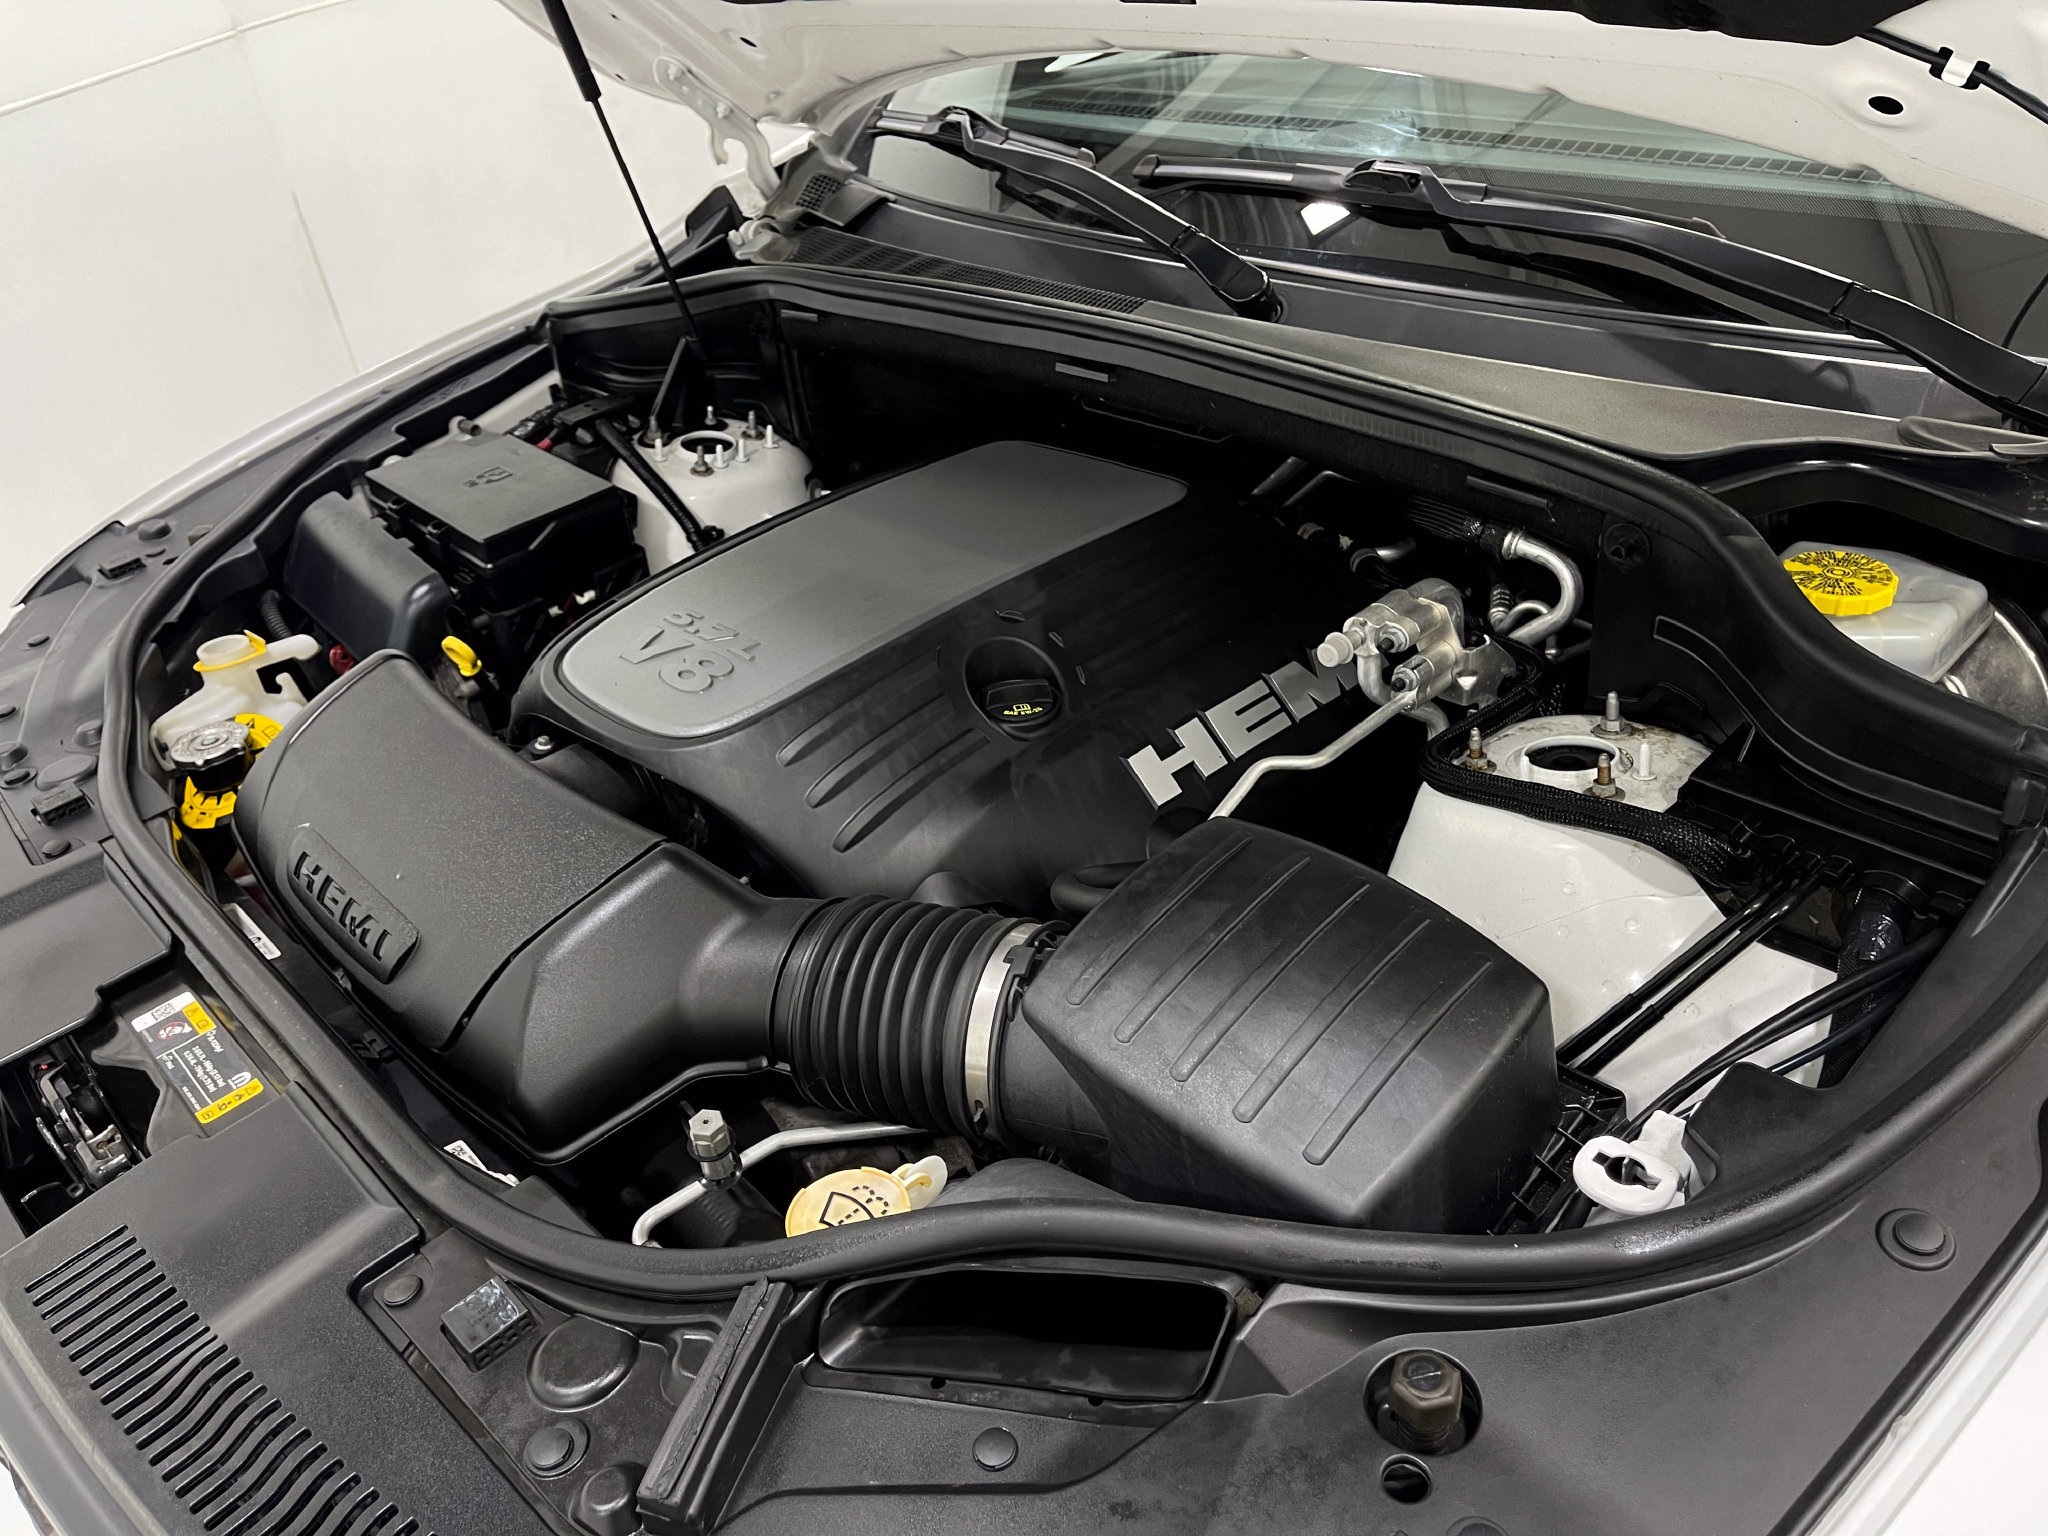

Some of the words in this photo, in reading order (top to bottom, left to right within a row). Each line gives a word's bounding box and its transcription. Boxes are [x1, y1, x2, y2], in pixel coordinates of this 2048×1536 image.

[619, 625, 735, 693] V8
[663, 609, 762, 662] 5.7L
[1120, 648, 1372, 811] HEM
[293, 851, 393, 962] HEMI
